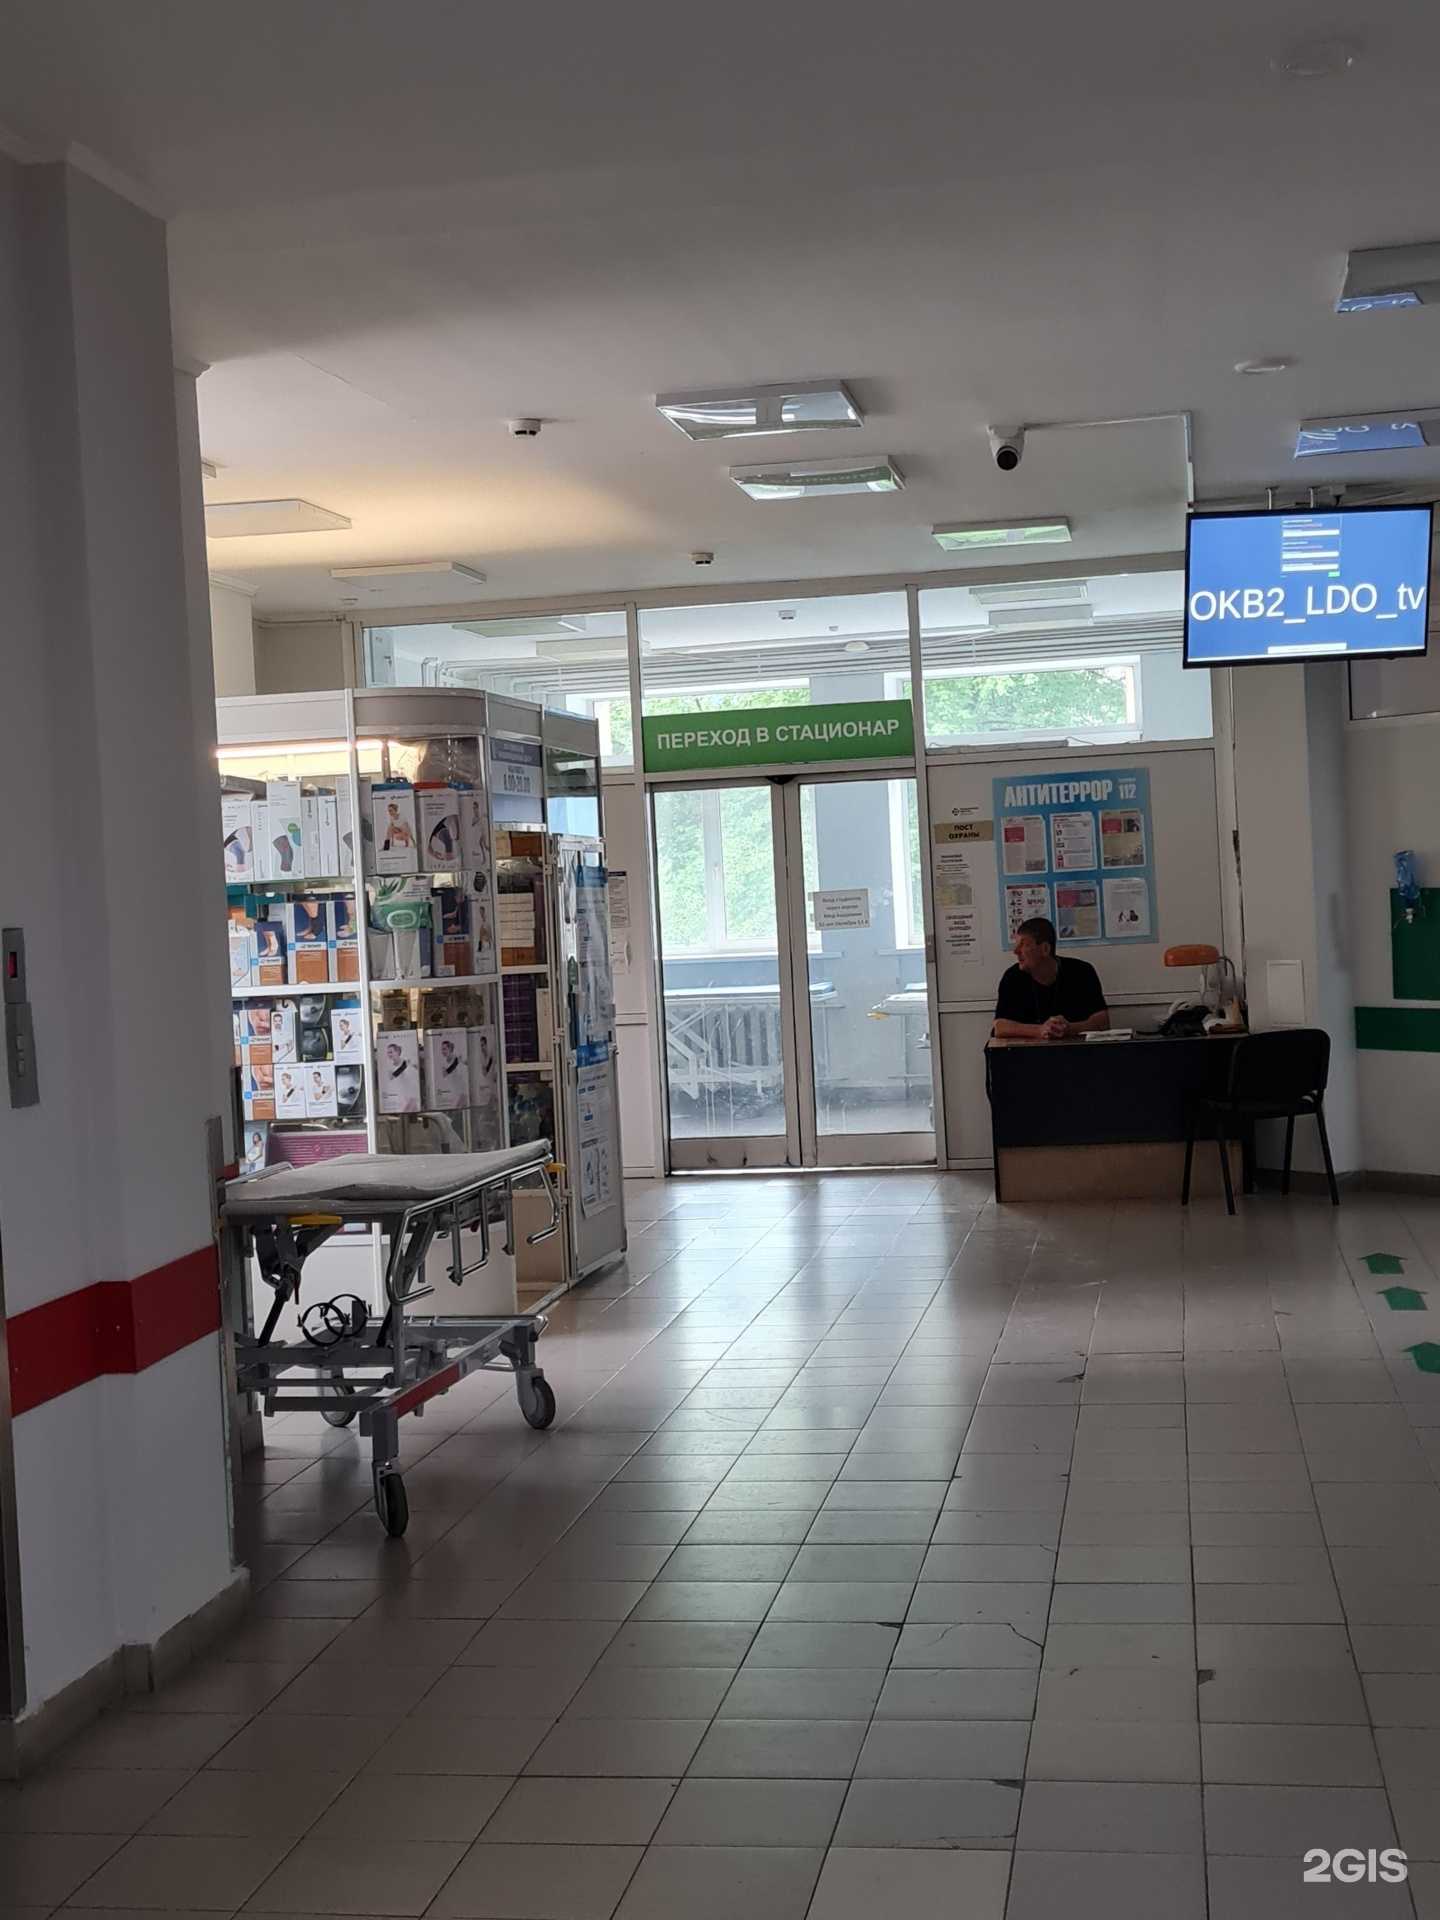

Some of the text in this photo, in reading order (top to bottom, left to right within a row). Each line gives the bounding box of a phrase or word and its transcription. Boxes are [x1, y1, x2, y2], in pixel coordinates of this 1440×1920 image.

[1189, 583, 1426, 625] OKB2_LDO_tv
[656, 718, 900, 750] ПЕРЕХОД В СТАЦИОНАР
[1003, 778, 1137, 808] АНТИТЕРРОР 112
[948, 831, 980, 840] ОХРАНЫ
[953, 823, 974, 831] ПОСТ
